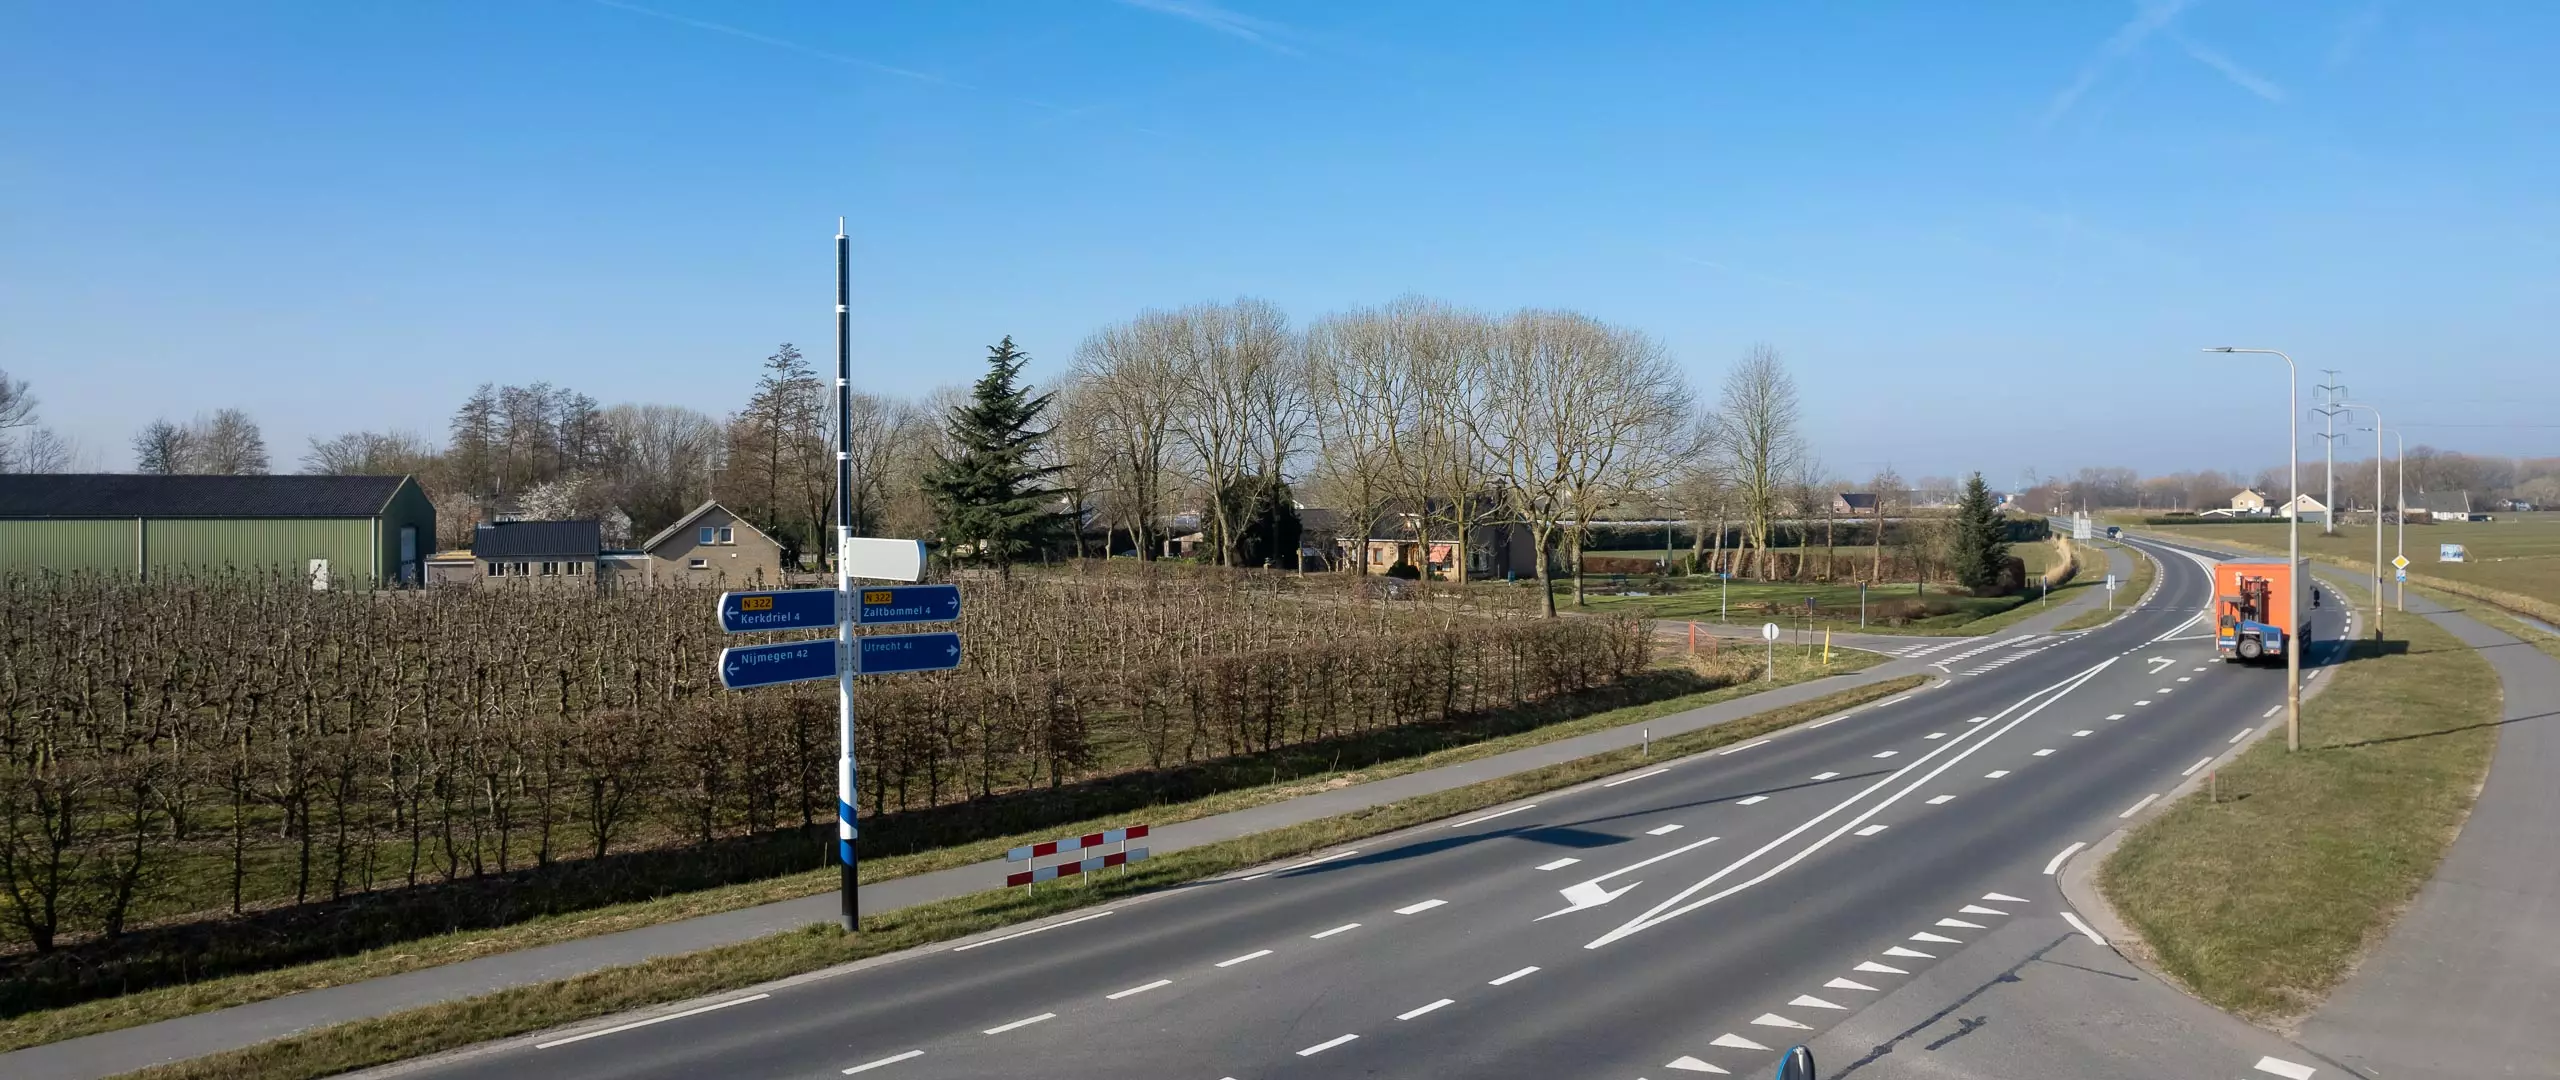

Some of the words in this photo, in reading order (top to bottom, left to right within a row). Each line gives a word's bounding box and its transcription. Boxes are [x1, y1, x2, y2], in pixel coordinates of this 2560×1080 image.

[866, 594, 872, 602] N
[875, 593, 890, 602] 322
[744, 600, 751, 608] N
[753, 599, 771, 607] 322
[864, 606, 922, 617] Zaltbommel
[741, 612, 790, 624] Kerkdriel
[794, 612, 800, 620] 4
[864, 642, 900, 652] Utrecht
[742, 652, 793, 666] Nijmegen
[796, 650, 808, 658] 42
